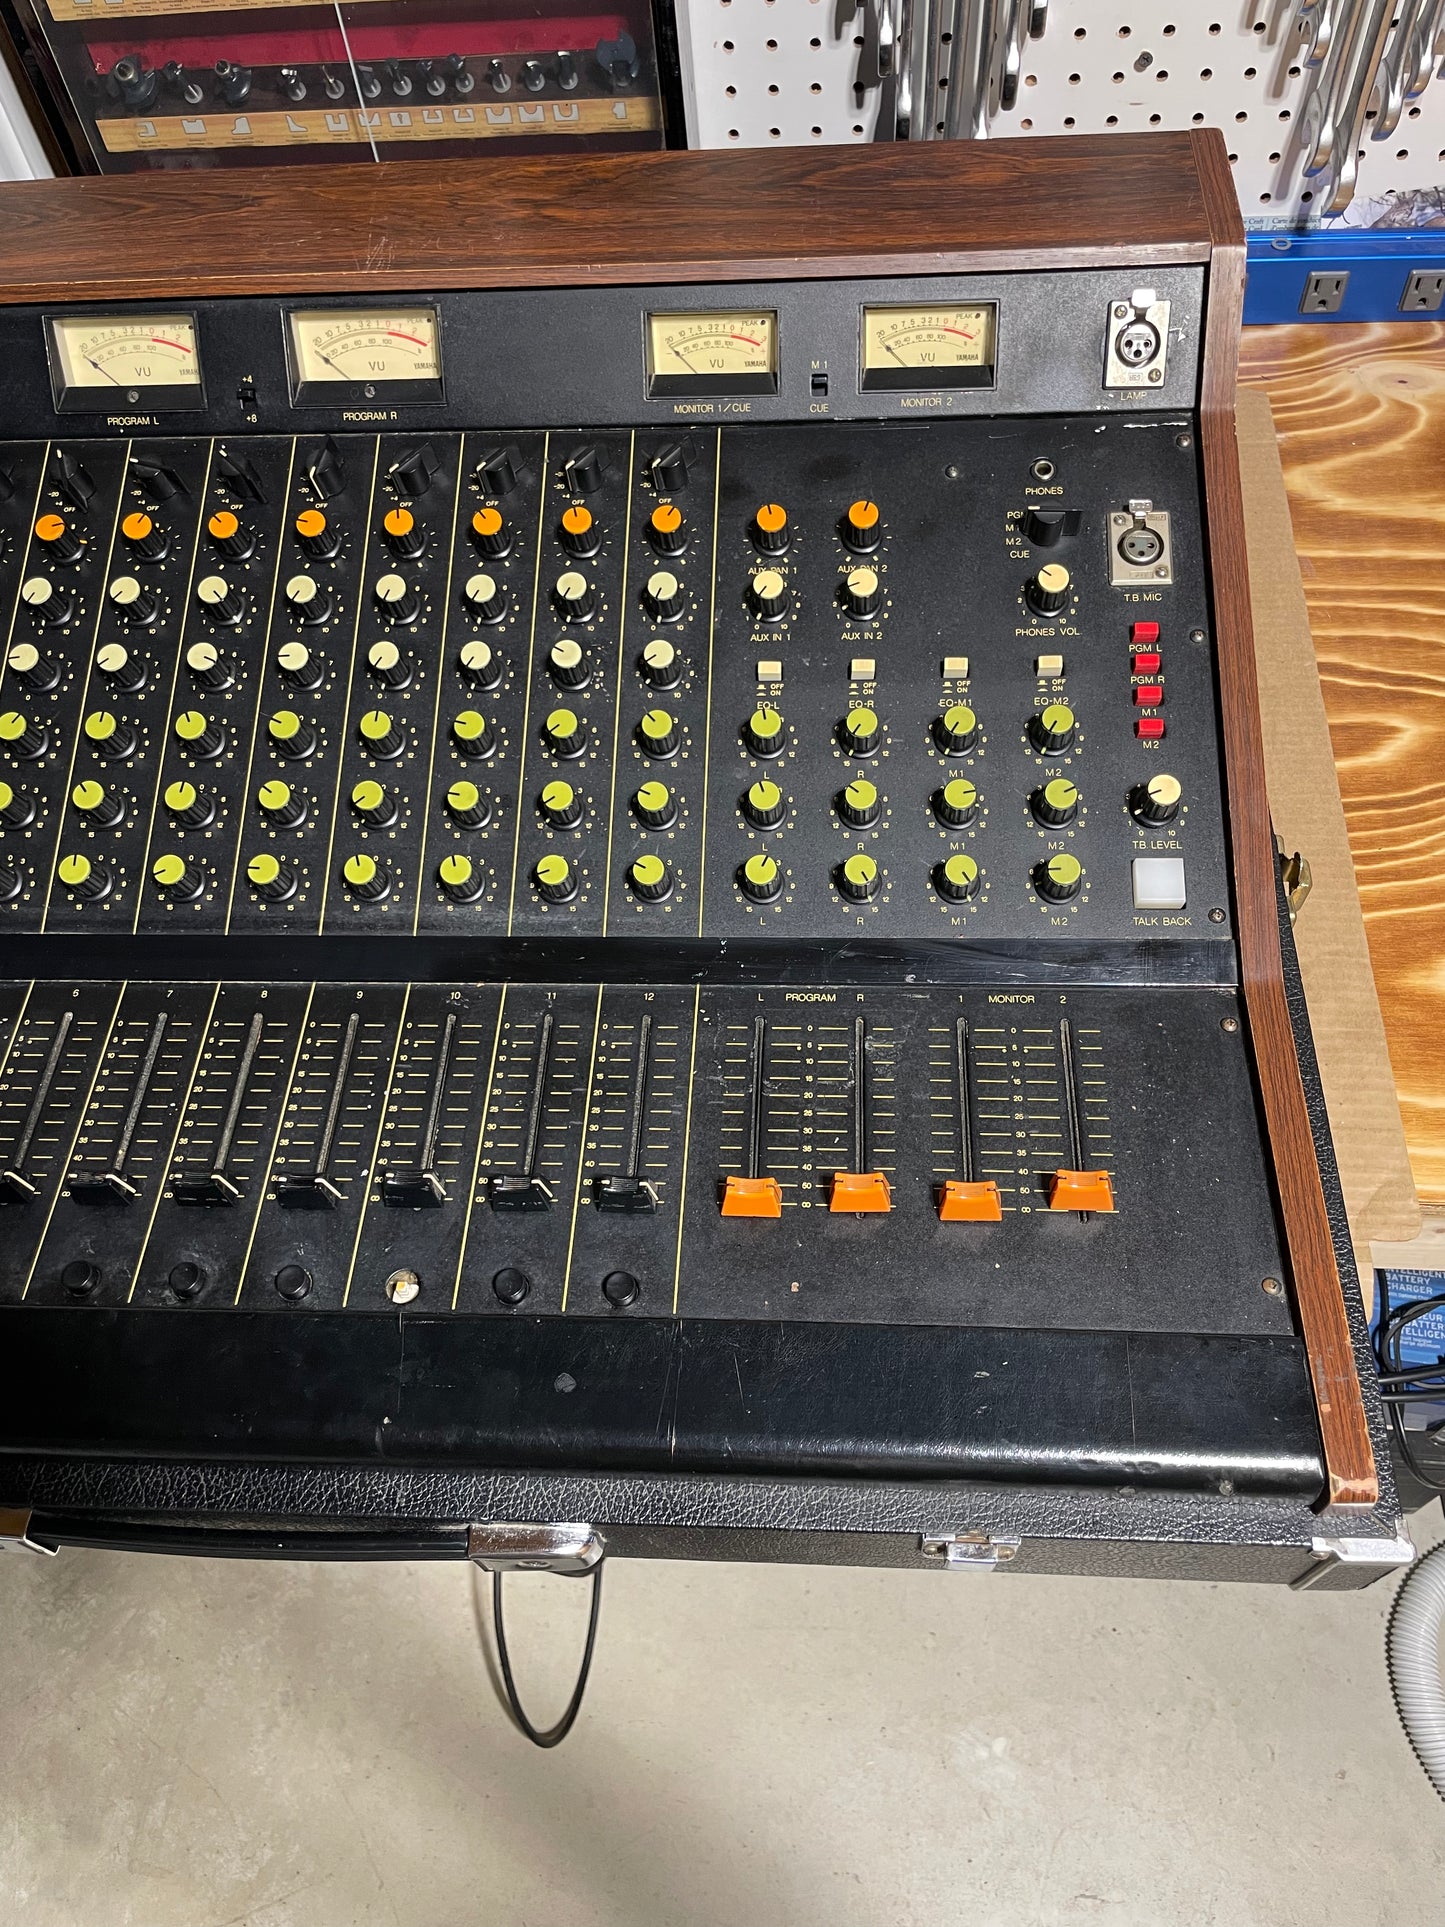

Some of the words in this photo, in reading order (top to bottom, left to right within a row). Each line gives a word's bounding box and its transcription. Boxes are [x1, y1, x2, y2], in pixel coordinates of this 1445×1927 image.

[920, 353, 936, 362] VU
[368, 361, 385, 371] VU
[709, 359, 724, 368] VU
[135, 367, 151, 377] VU
[1120, 391, 1147, 401] LAMP
[900, 398, 942, 408] MONITOR
[946, 397, 953, 406] 2
[674, 404, 714, 414] MONITOR
[809, 404, 829, 413] CUE
[343, 412, 387, 421] PROGRAM
[390, 411, 398, 420] R
[107, 417, 150, 426] PROGRAM
[153, 416, 160, 425] L
[1025, 487, 1064, 495] PHONES
[1009, 550, 1030, 559] CUE
[748, 567, 767, 575] AUX
[837, 565, 857, 573] AUX
[882, 564, 888, 573] 2
[1143, 593, 1163, 602] MIC
[841, 632, 861, 641] AUX
[864, 632, 874, 640] IN
[876, 632, 883, 640] 2
[1015, 628, 1056, 637] PHONES
[750, 634, 770, 642] AUX
[773, 633, 783, 642] IN
[1129, 644, 1152, 653] PGM
[1156, 644, 1163, 652] L
[1130, 676, 1154, 684] PGM
[1157, 675, 1165, 684] R
[763, 771, 770, 780] L
[858, 770, 865, 779] R
[762, 843, 768, 852] L
[858, 843, 865, 851] R
[1151, 840, 1183, 850] LEVEL
[760, 917, 767, 926] L
[856, 917, 865, 926] R
[1133, 917, 1159, 926] TALK
[1162, 917, 1192, 926] BACK
[166, 989, 174, 998] 7
[260, 990, 268, 999] 8
[356, 991, 364, 1000] 9
[450, 991, 461, 1000] 10
[547, 992, 557, 1000] 11
[643, 992, 655, 1001] 12
[758, 993, 764, 1002] L
[785, 993, 837, 1002] PROGRAM
[856, 994, 864, 1002] R
[988, 995, 1035, 1003] MONITOR
[1059, 996, 1067, 1004] 2
